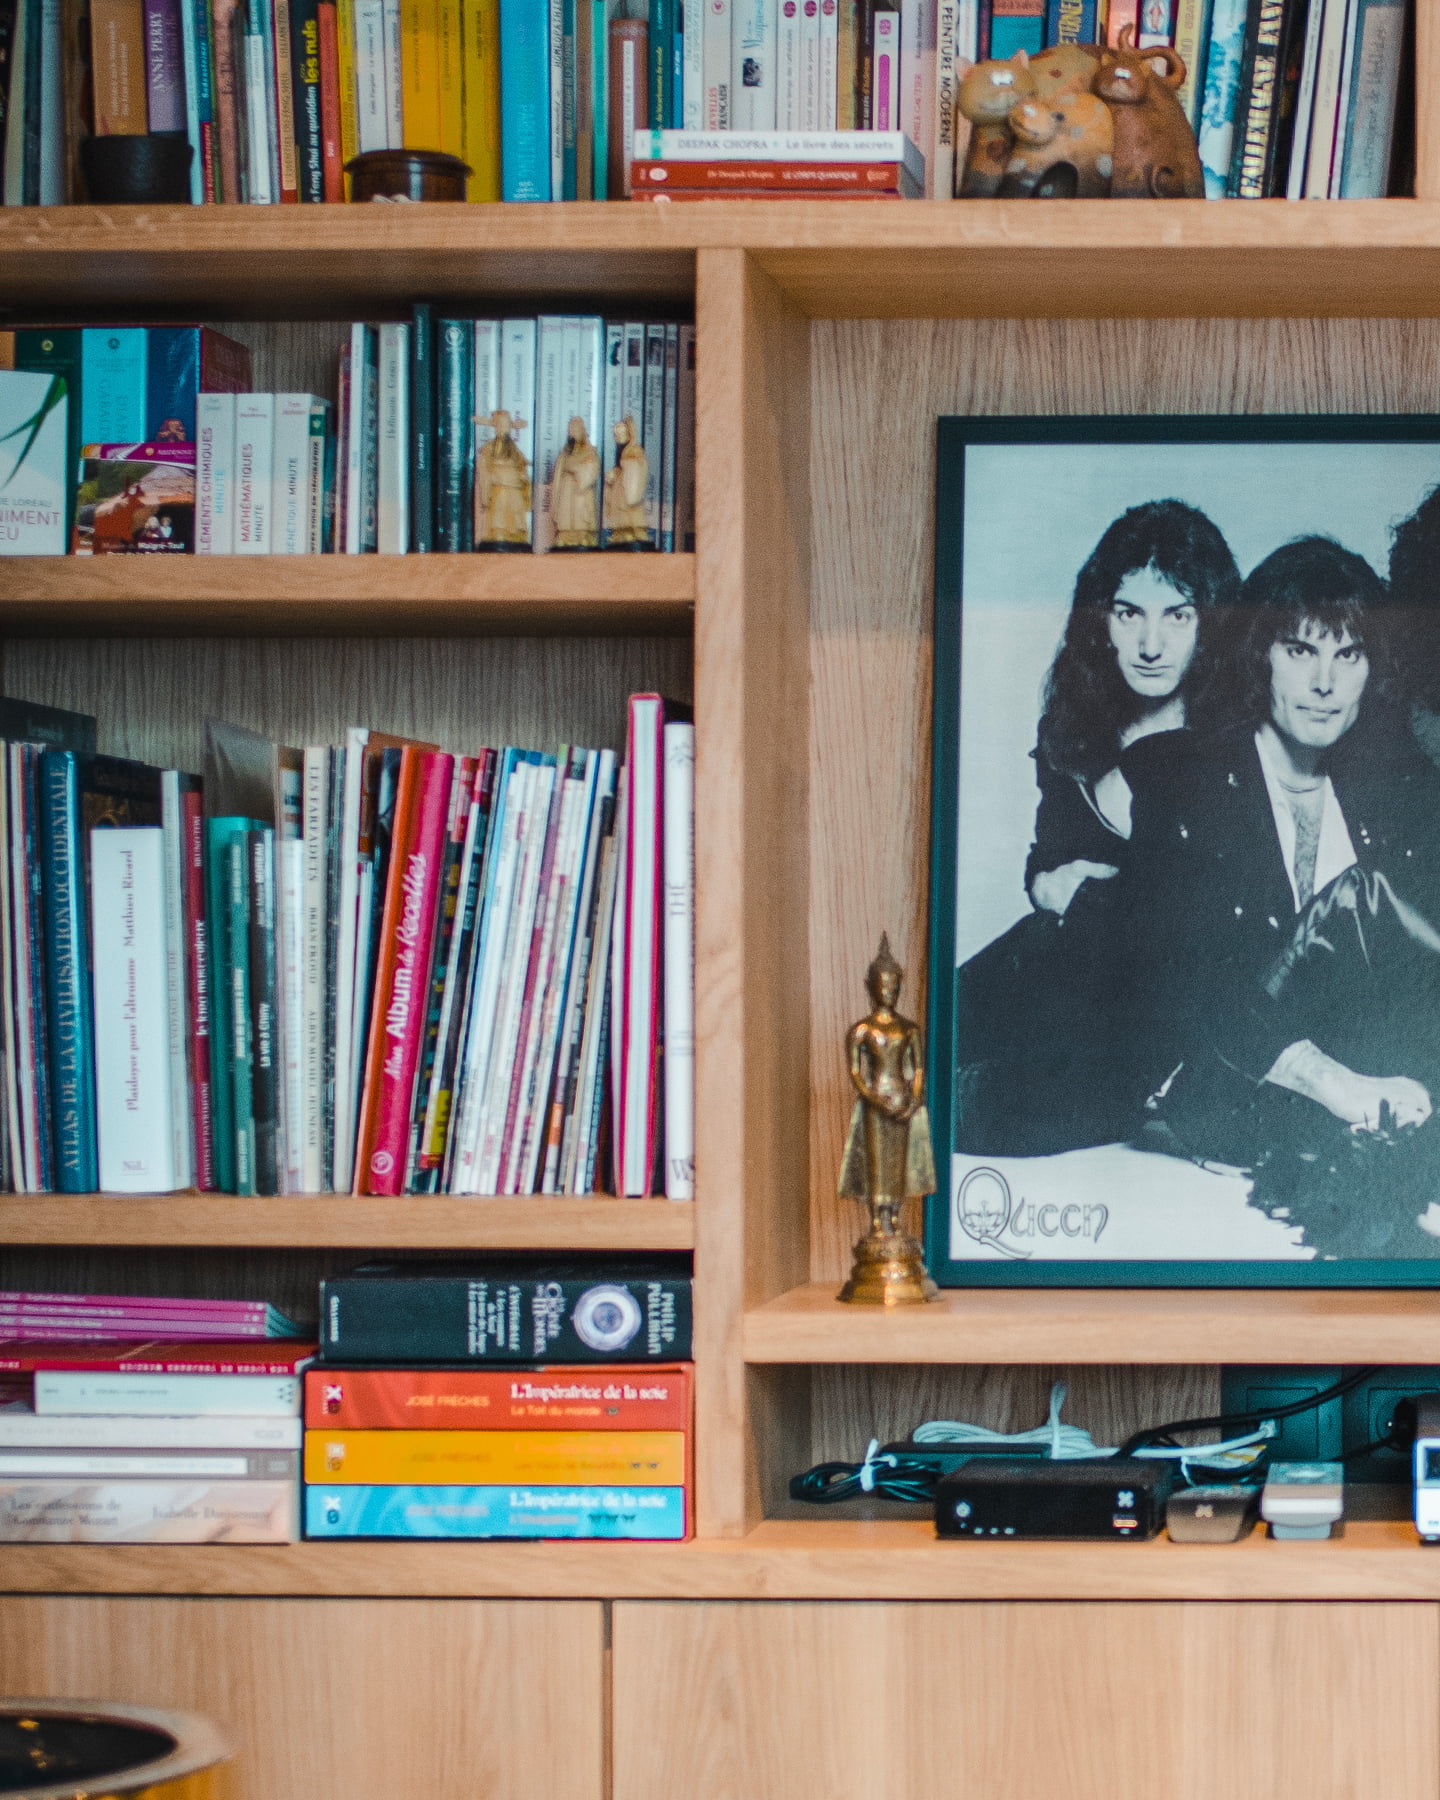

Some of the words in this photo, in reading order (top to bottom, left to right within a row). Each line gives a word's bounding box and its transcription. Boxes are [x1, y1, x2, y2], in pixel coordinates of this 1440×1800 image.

[150, 11, 163, 51] PERRY
[302, 20, 317, 54] nuls
[939, 6, 953, 71] PEINTURE
[151, 55, 166, 92] ANNE
[306, 86, 319, 132] quotidien
[939, 78, 952, 145] MODERNE
[308, 148, 320, 169] Shui
[309, 134, 318, 146] au
[677, 139, 720, 149] DEEPAK
[723, 139, 768, 148] CHOPRA
[310, 170, 322, 194] Feng
[201, 427, 213, 492] CHIMIQUES
[288, 457, 298, 495] MINUTE
[215, 469, 225, 514] MINUTE
[239, 443, 253, 542] MATHÉMATIQUES
[255, 504, 263, 542] MINUTE
[49, 767, 70, 902] OCCIDENTALE
[120, 850, 134, 889] Ricard
[395, 851, 428, 946] Recettes
[121, 893, 135, 947] Matthieu
[54, 906, 76, 1041] CIVILISATION
[397, 949, 416, 967] de
[386, 967, 412, 1039] Album
[126, 1023, 140, 1051] pour
[59, 1047, 77, 1070] LA
[384, 1045, 404, 1080] Mon
[60, 1078, 78, 1103] DE
[125, 1054, 141, 1111] Plaidoyer
[63, 1110, 80, 1170] ATLAS
[957, 1166, 1108, 1260] Queen
[647, 1283, 662, 1355] PULLMAN
[661, 1293, 676, 1343] PHILIP
[511, 1383, 601, 1401] L'Impératrice
[604, 1384, 622, 1400] de
[550, 1405, 566, 1416] du
[568, 1405, 601, 1416] monde
